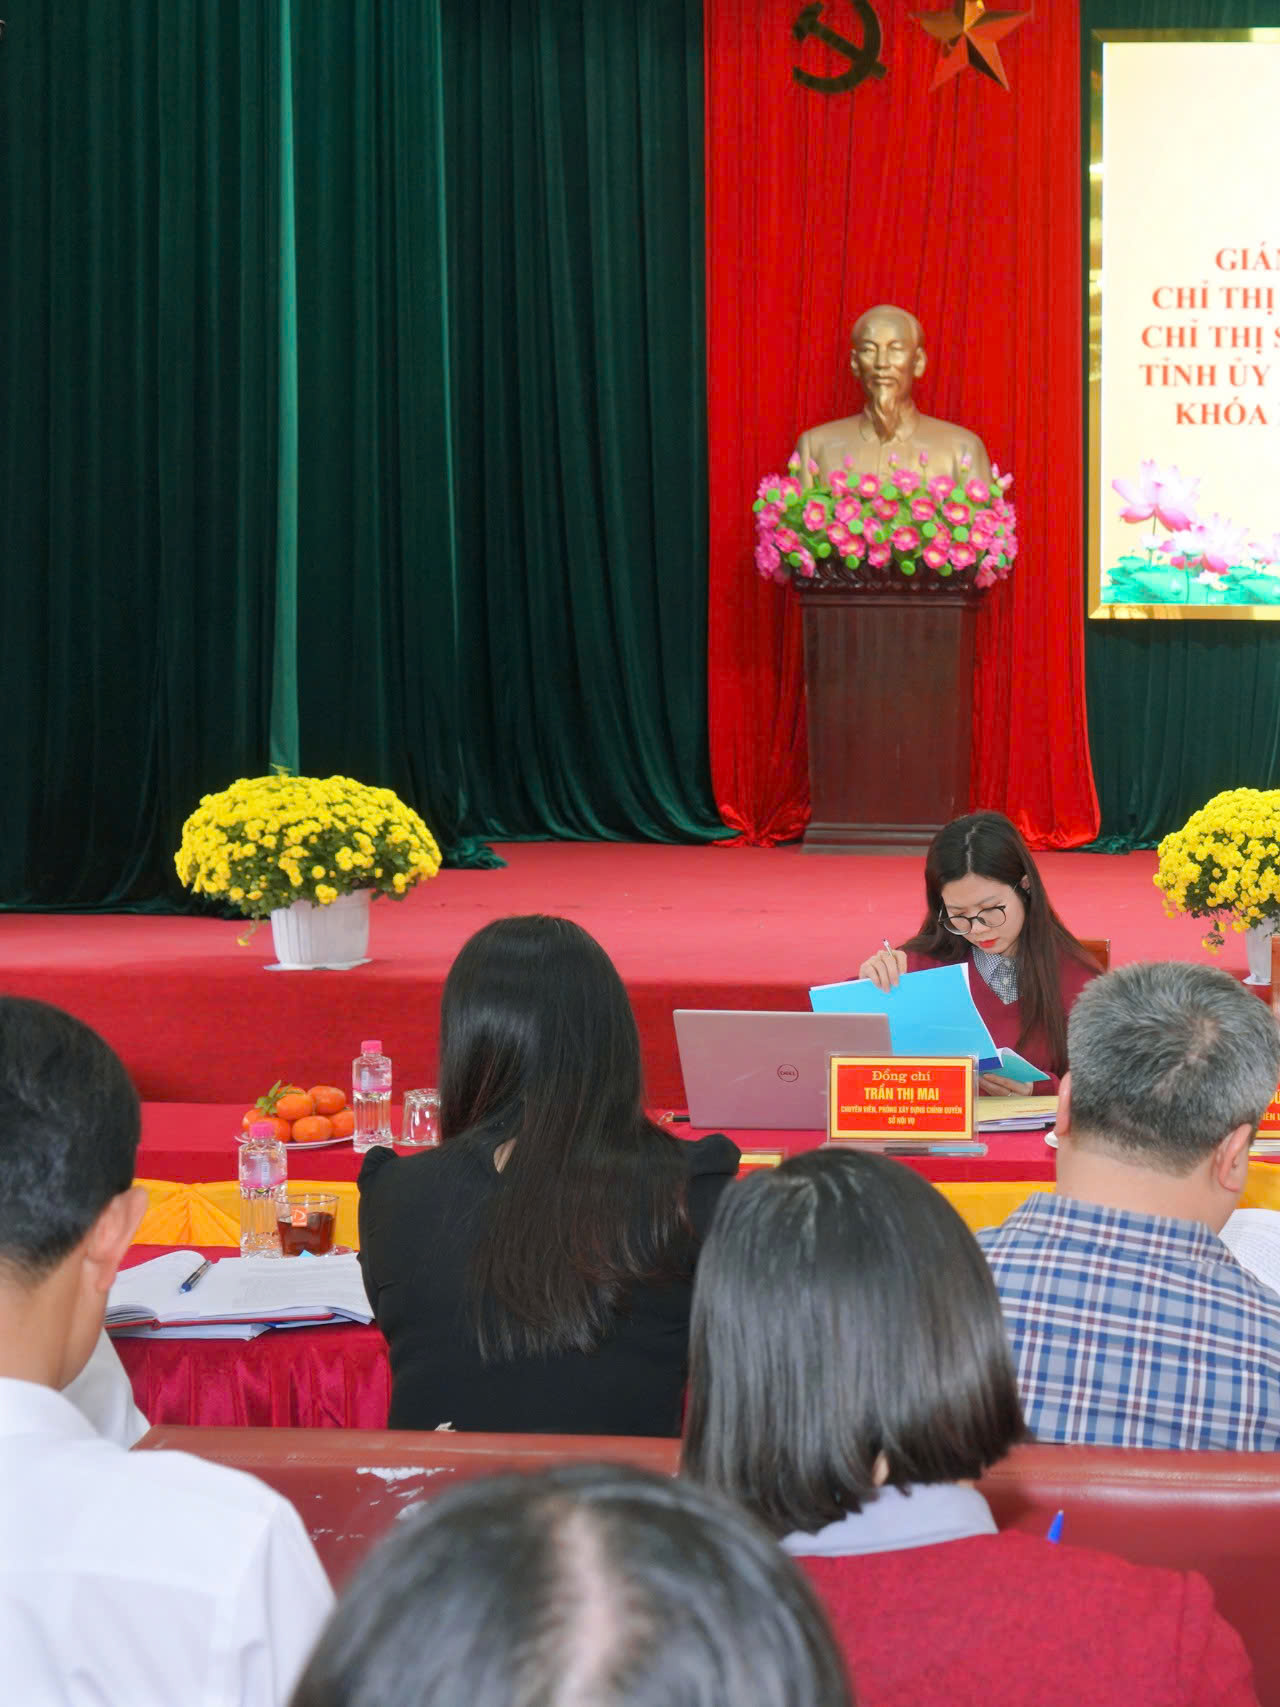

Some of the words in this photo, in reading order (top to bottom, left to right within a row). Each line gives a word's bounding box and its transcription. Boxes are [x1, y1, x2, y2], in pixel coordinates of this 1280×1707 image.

[1152, 280, 1208, 310] CHỈ
[1219, 287, 1273, 316] THỊ
[1141, 319, 1198, 349] CHỈ
[1208, 325, 1262, 354] THỊ
[1139, 357, 1216, 387] TỈNH
[1228, 357, 1271, 387] ỦY
[1176, 396, 1268, 426] KHÓA
[872, 1068, 907, 1083] Đồng
[910, 1069, 931, 1081] chí
[897, 1087, 914, 1103] THỊ
[917, 1087, 939, 1100] MAI
